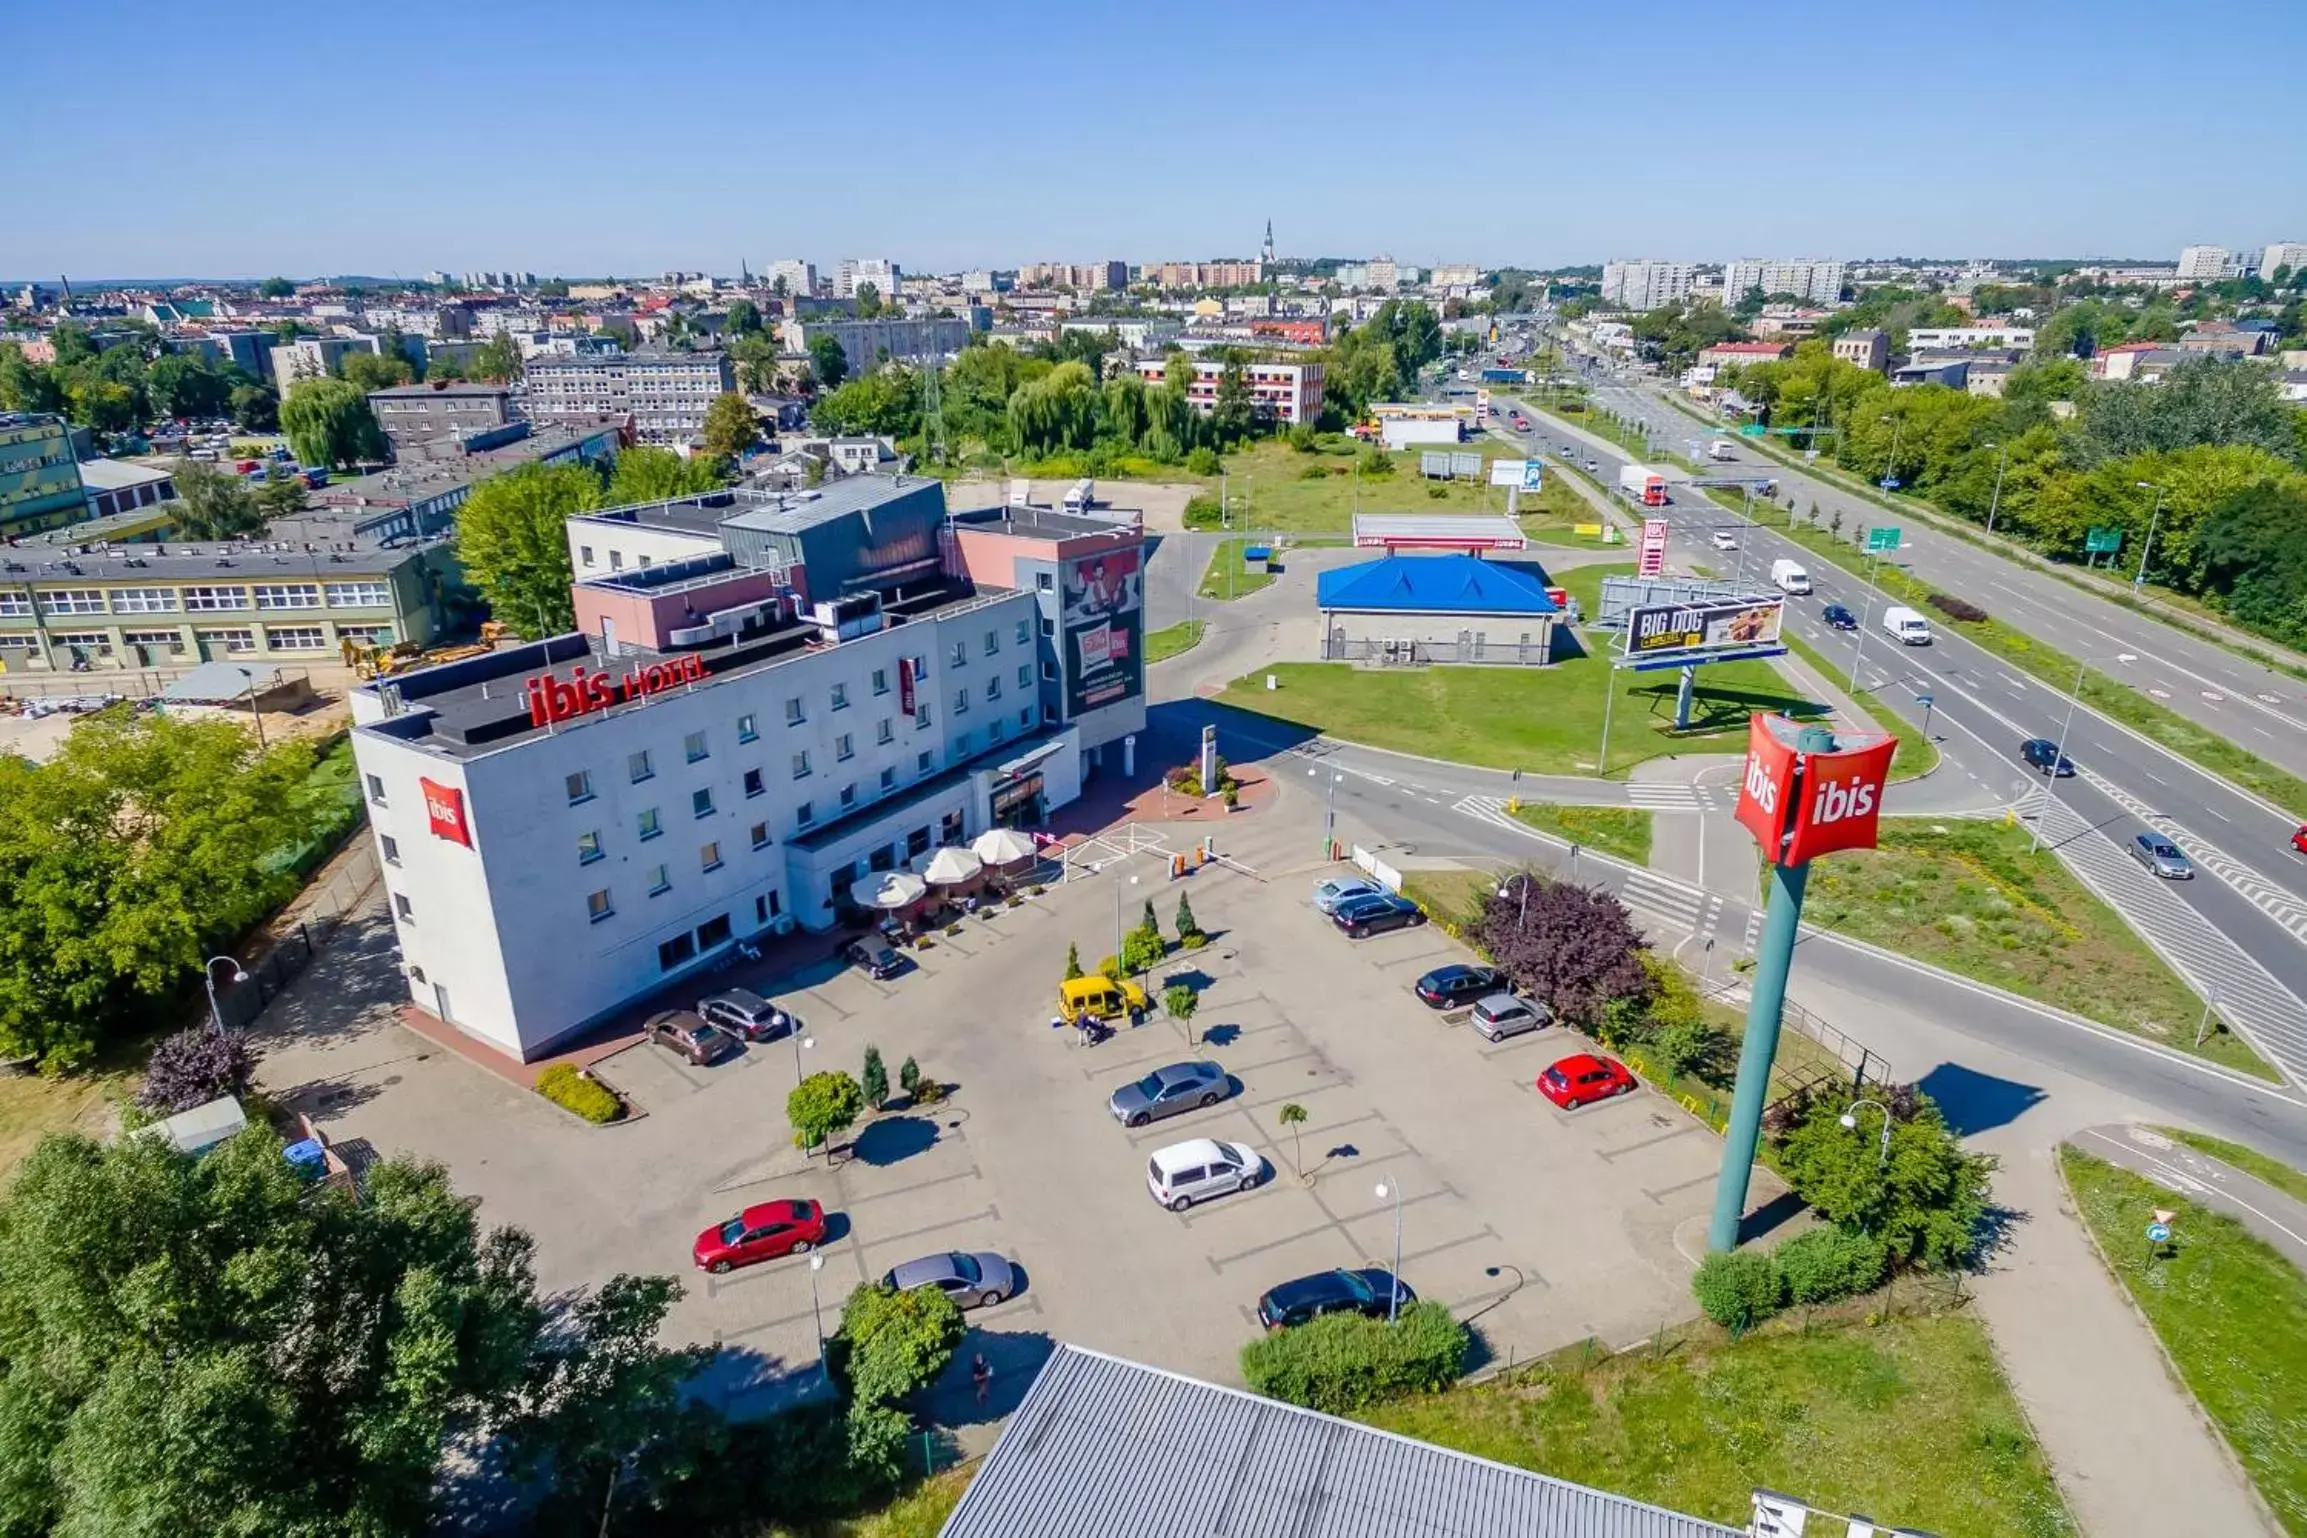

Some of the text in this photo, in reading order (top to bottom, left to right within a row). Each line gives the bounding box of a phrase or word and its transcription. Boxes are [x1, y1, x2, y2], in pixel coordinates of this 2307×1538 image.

[1640, 610, 1704, 637] BIG DOG
[527, 653, 712, 727] ibis HOTEL
[1746, 751, 1777, 815] ibis
[1812, 776, 1875, 825] ibis
[429, 798, 456, 825] ibis
